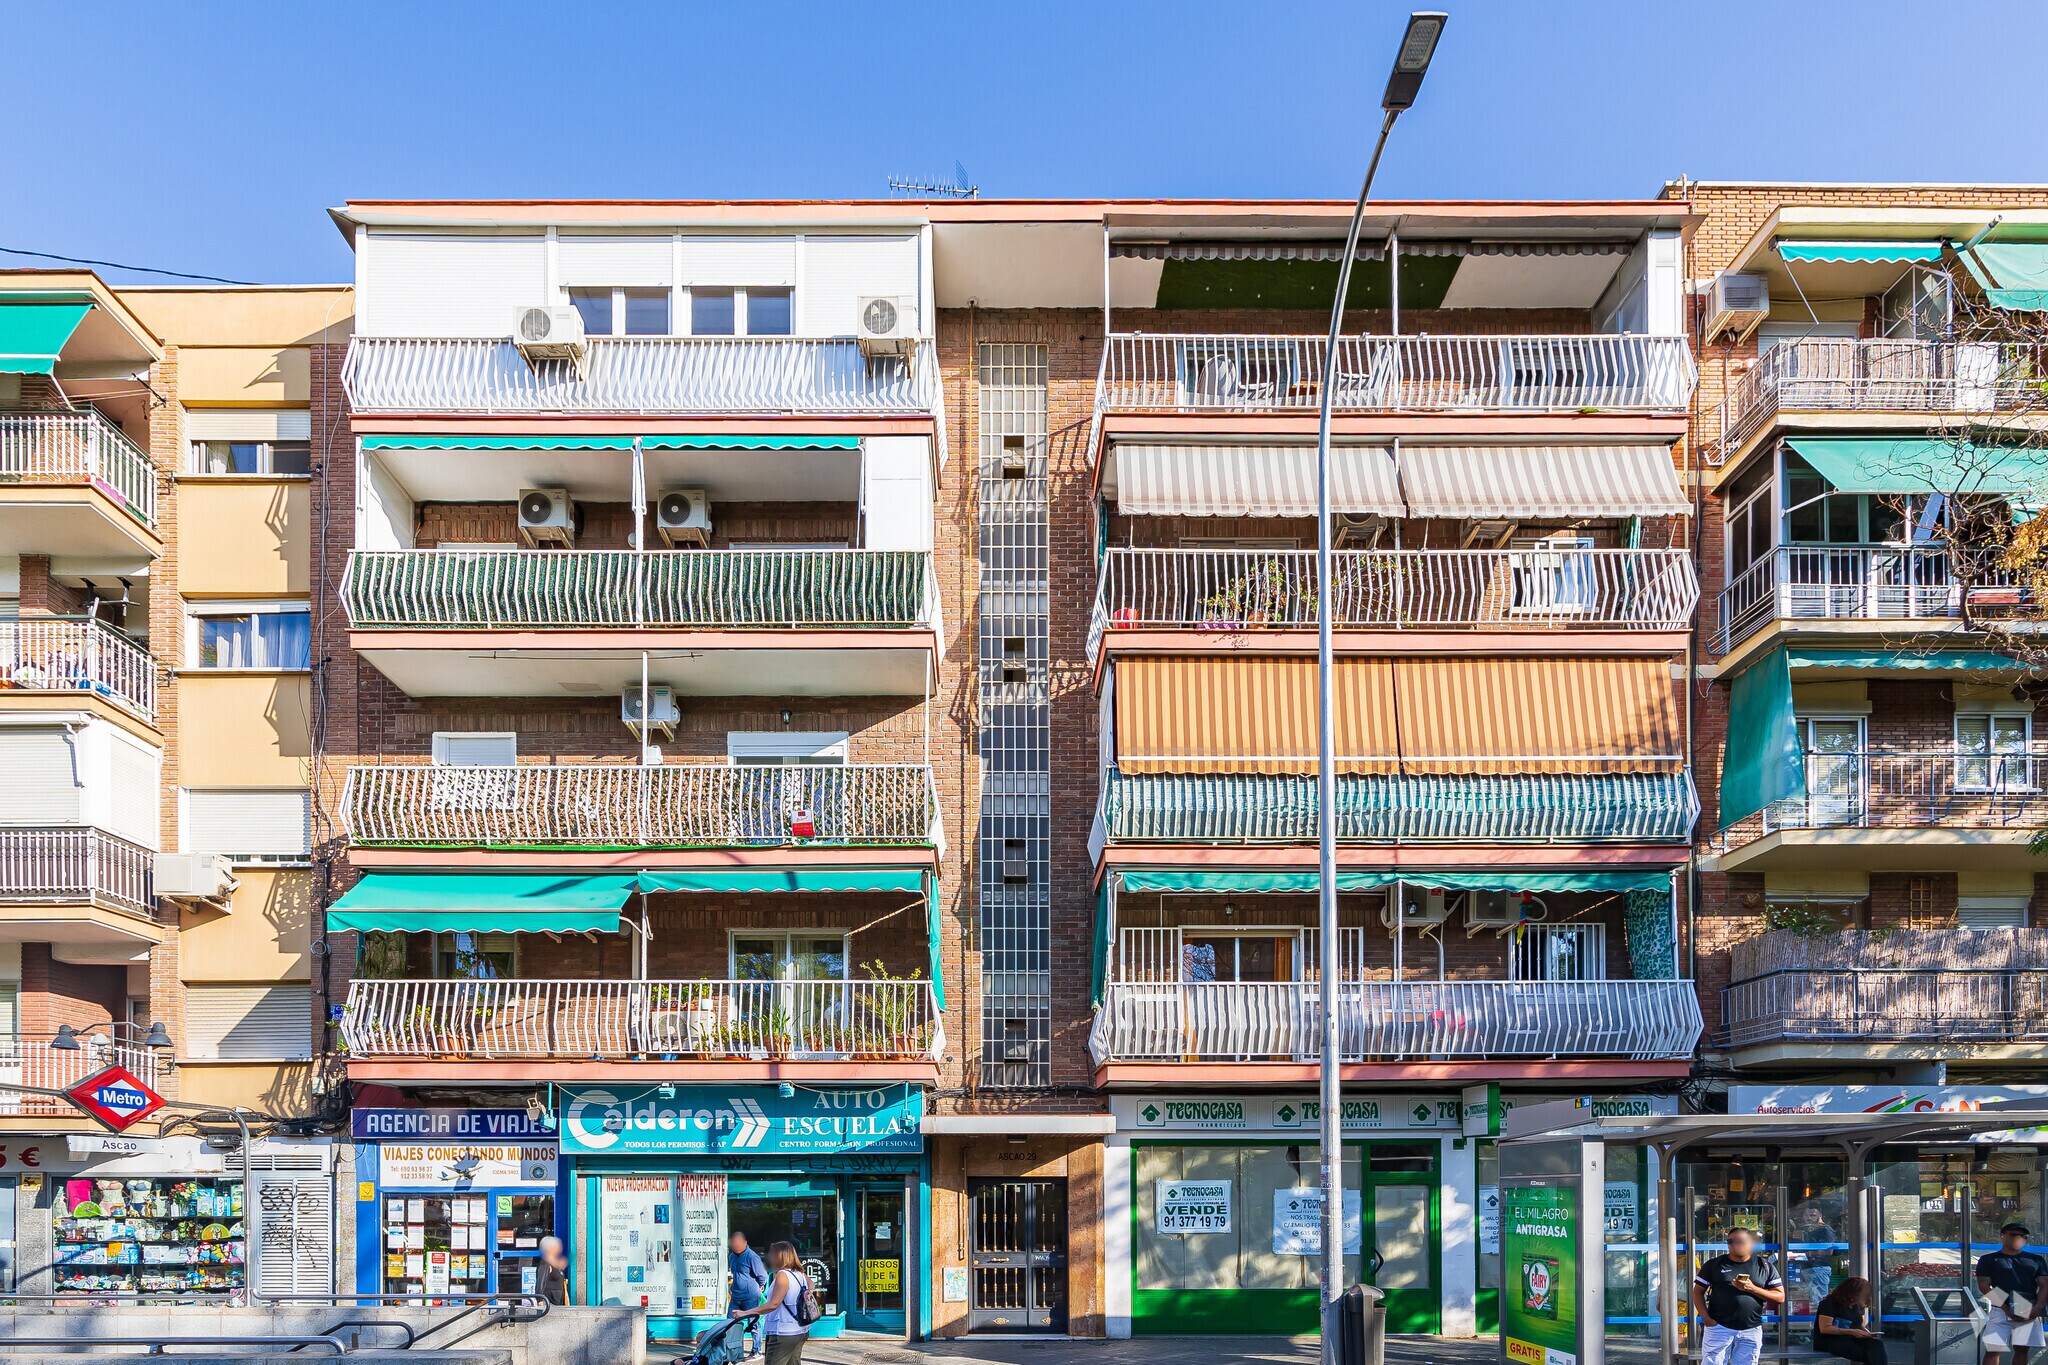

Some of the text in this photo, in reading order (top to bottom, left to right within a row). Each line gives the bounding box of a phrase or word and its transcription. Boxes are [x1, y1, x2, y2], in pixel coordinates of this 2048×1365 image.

[102, 1090, 143, 1106] Metro
[813, 1091, 886, 1109] AUTO
[1166, 1102, 1243, 1120] TECNOCASA
[1302, 1102, 1378, 1120] TEOCASA
[1757, 1104, 1816, 1114] Autoservicios
[366, 1114, 450, 1133] AGENCIA
[458, 1114, 480, 1133] DE
[567, 1090, 736, 1149] Calderon
[102, 1140, 137, 1150] Ascao
[18, 1146, 40, 1168] €
[384, 1147, 555, 1160] VIAJES CONECTANDO MUNDOS
[606, 1178, 624, 1192] NUEVA
[676, 1175, 726, 1192] APROVECHATE
[1182, 1187, 1223, 1196] TECNOCASA
[1164, 1206, 1227, 1215] VENDE
[1514, 1207, 1569, 1221] EL MILAGRO
[1164, 1217, 1226, 1227] 91 377 19 79
[1607, 1219, 1633, 1229] 19 79
[1516, 1224, 1568, 1238] ANTIGRASA
[1531, 1273, 1547, 1289] FAIRY
[1510, 1342, 1540, 1360] GRATIS
